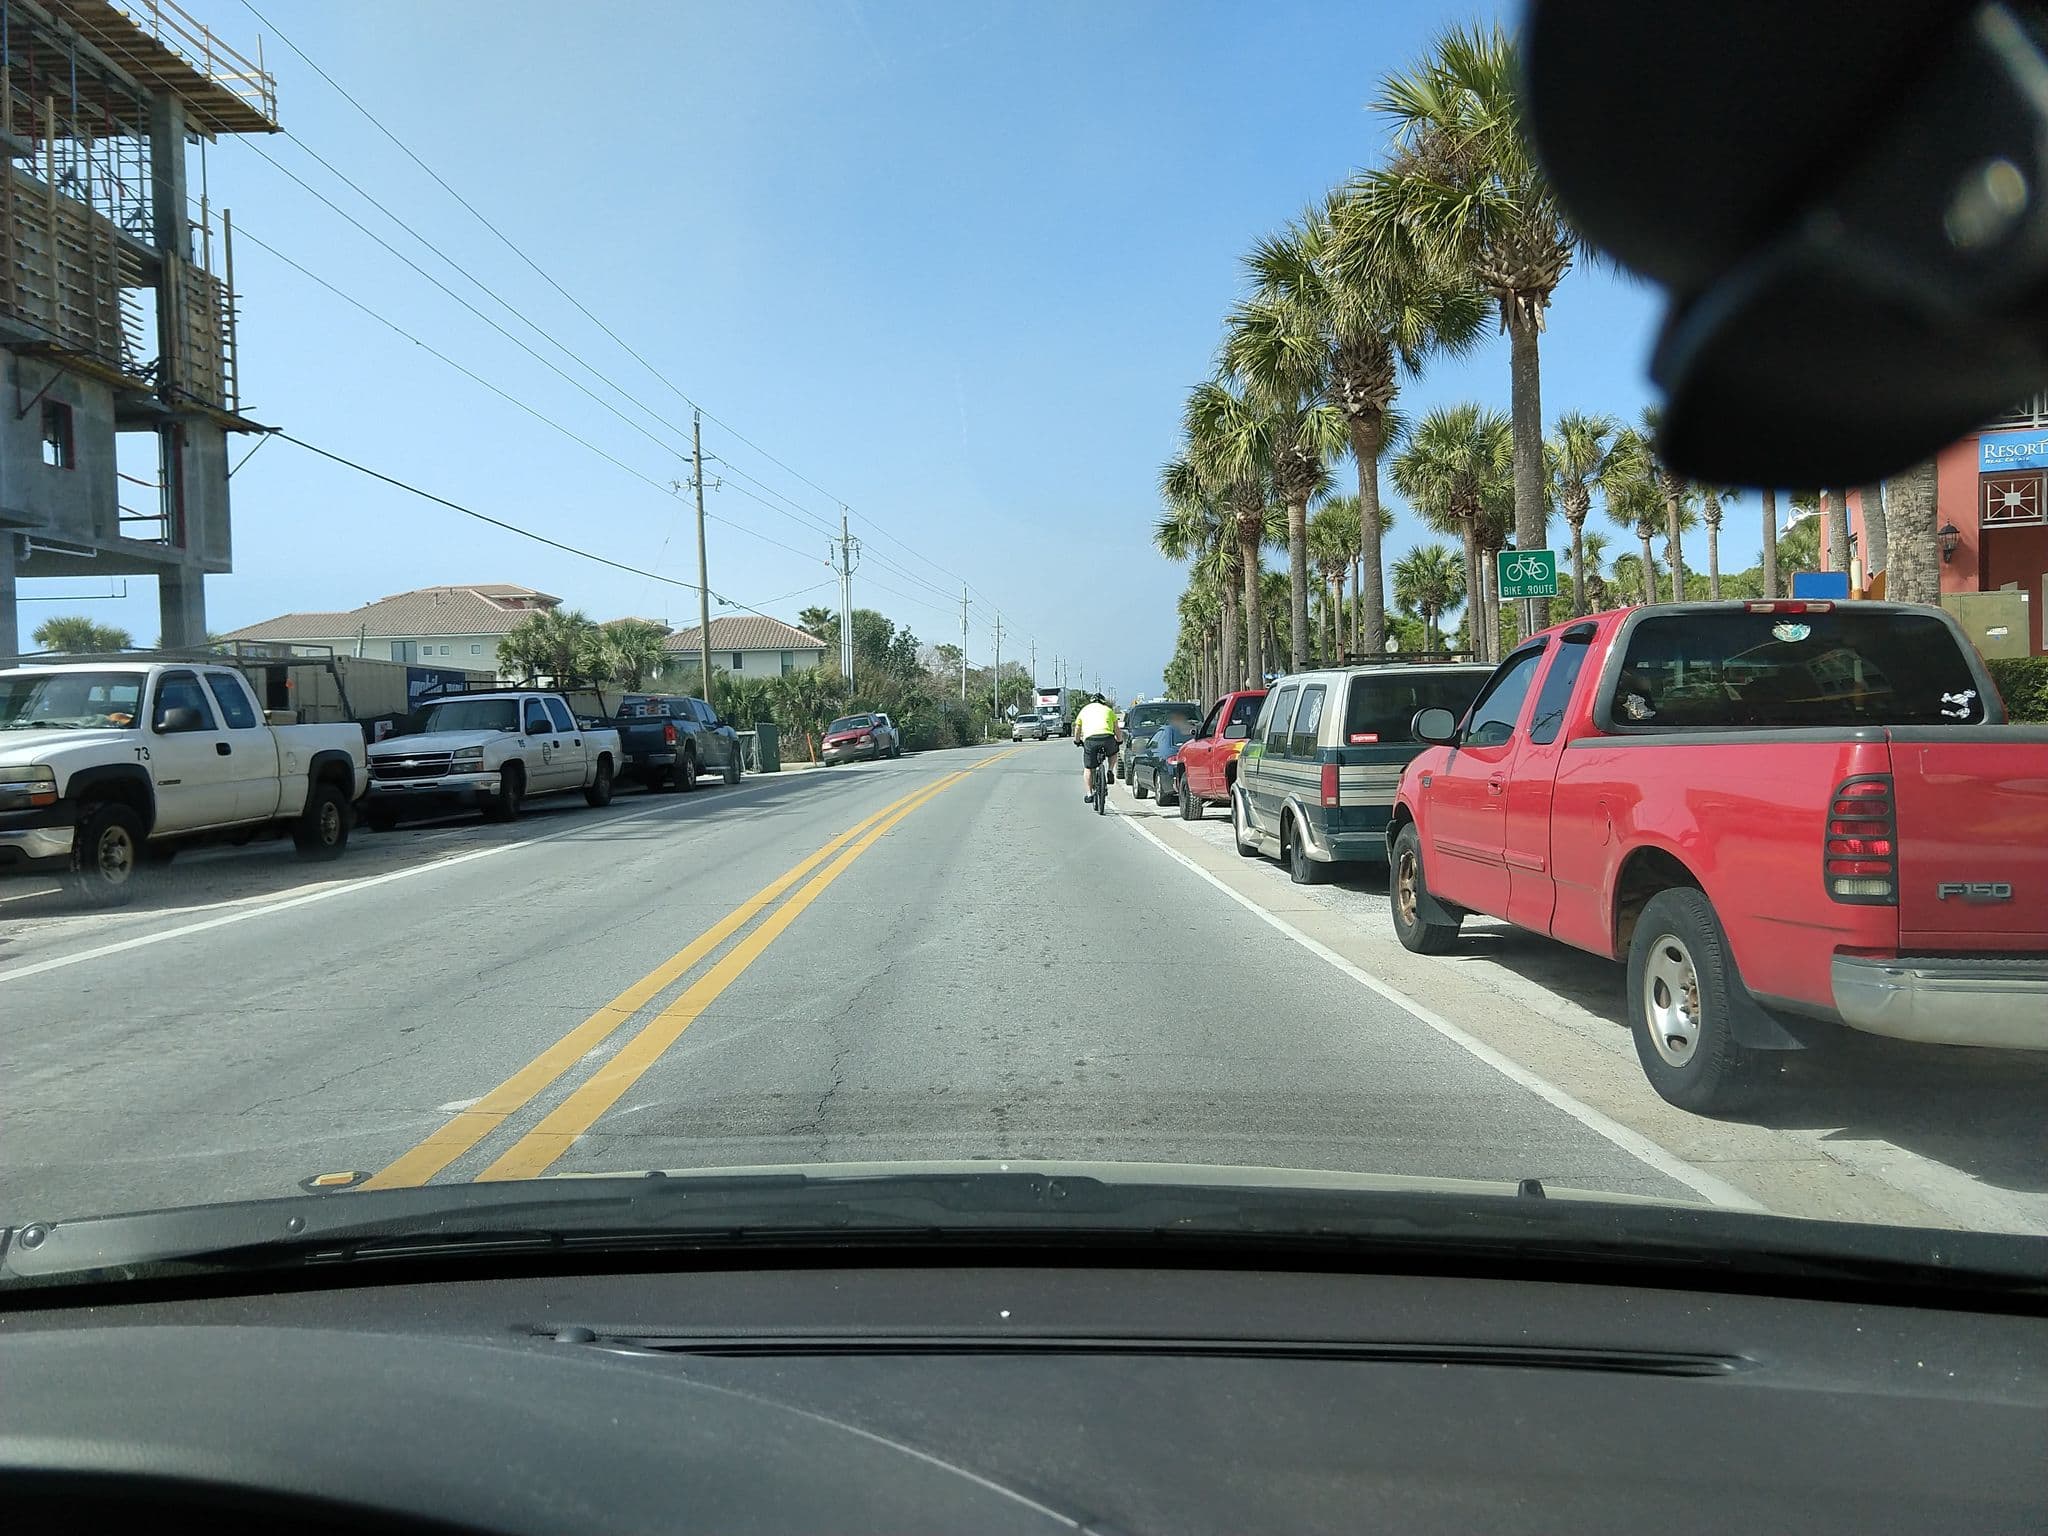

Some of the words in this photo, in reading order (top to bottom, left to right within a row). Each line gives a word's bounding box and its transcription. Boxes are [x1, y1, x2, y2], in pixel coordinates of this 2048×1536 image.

[1503, 586, 1522, 596] BIKE
[1527, 584, 1554, 595] ROUTE
[134, 746, 150, 760] 73
